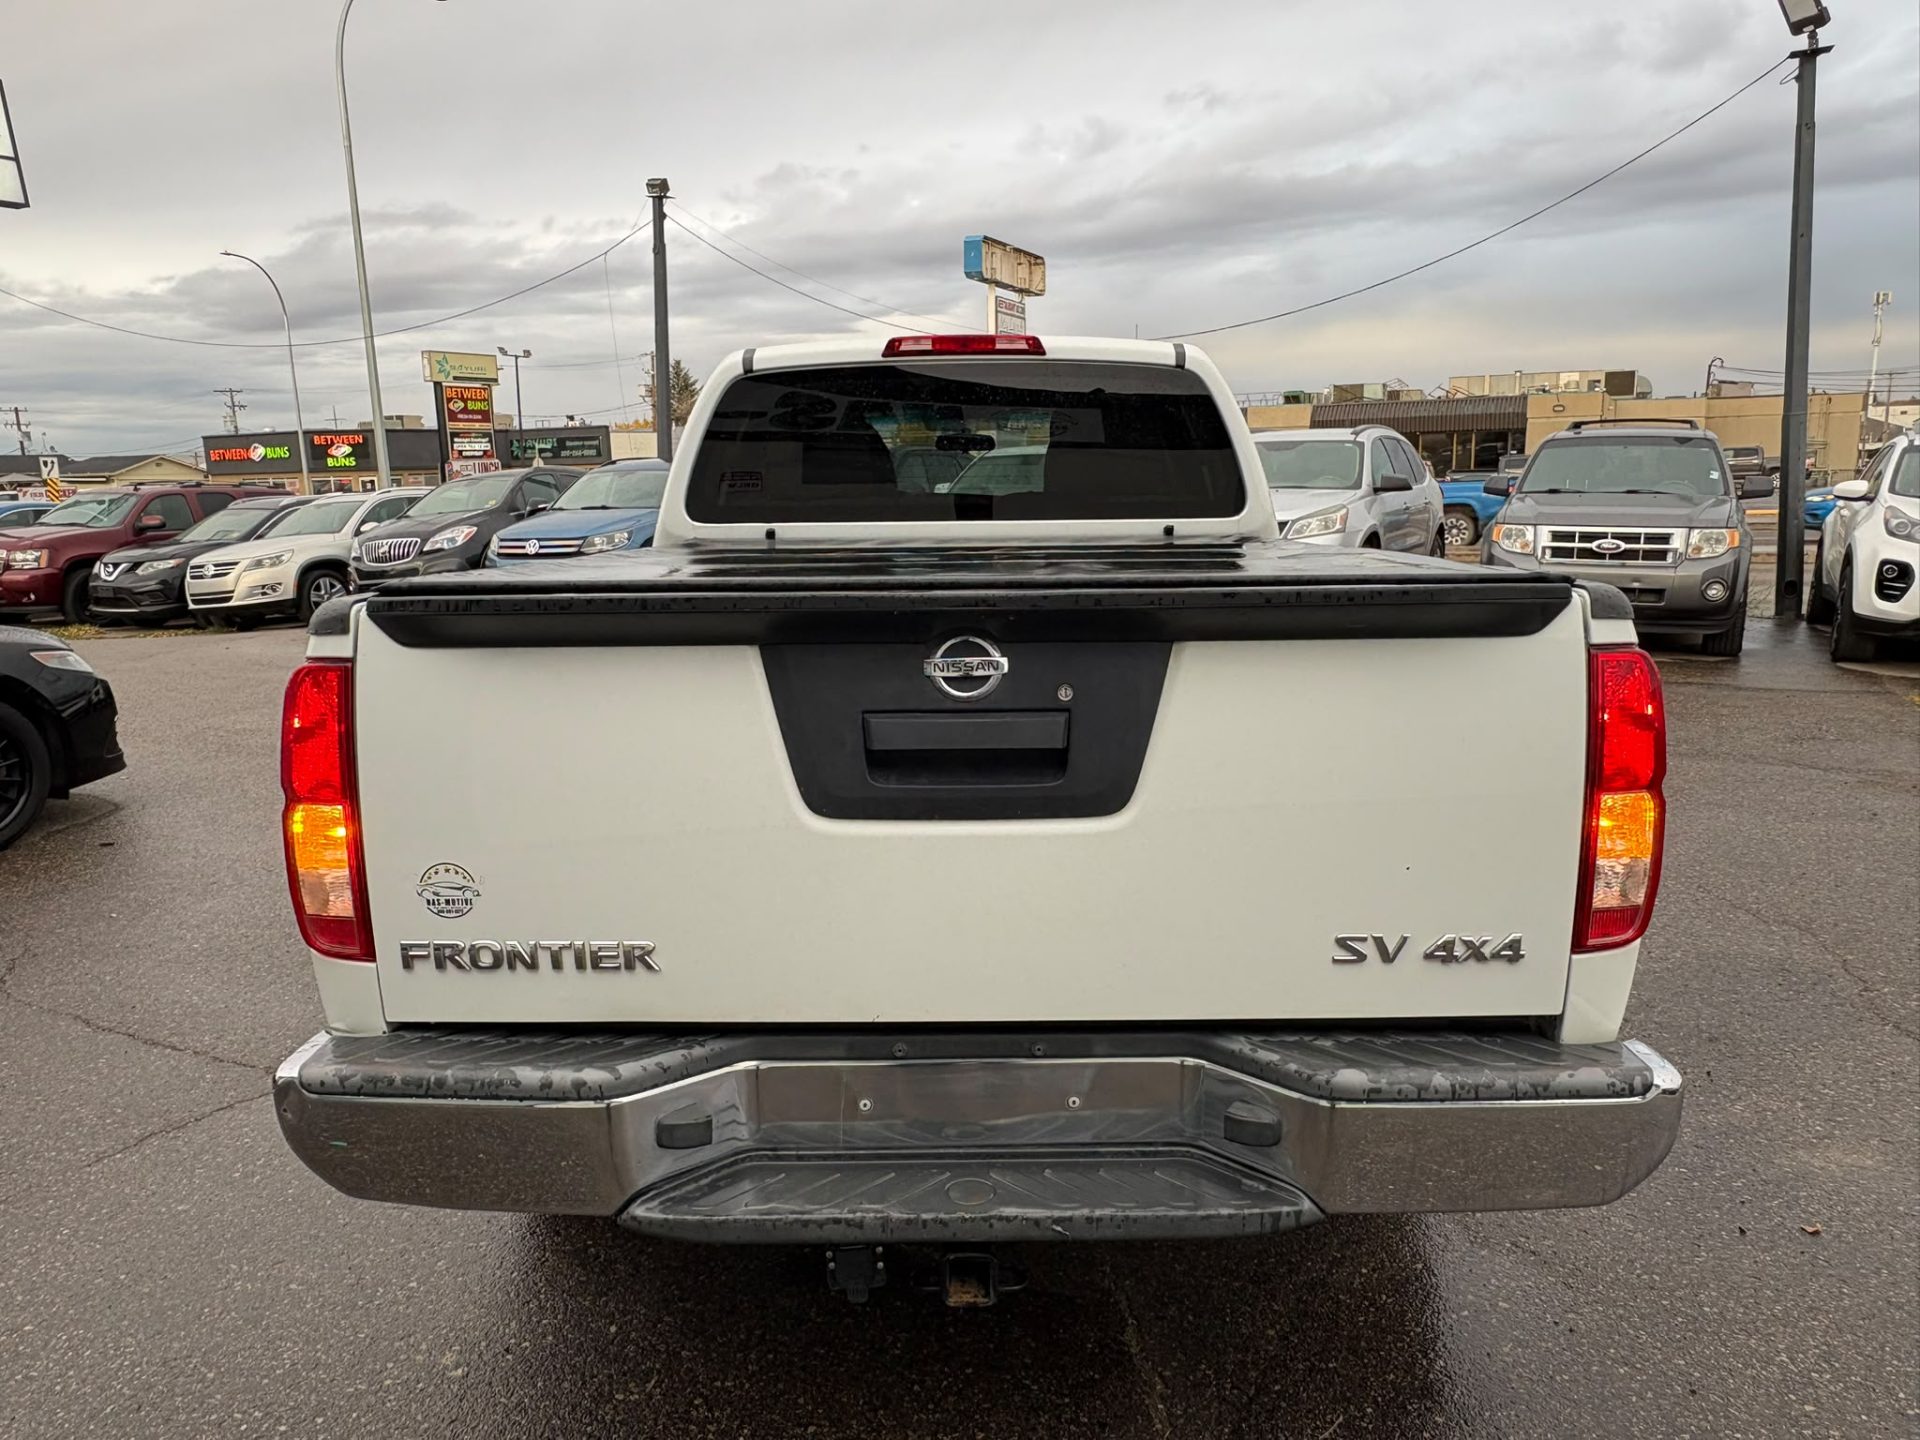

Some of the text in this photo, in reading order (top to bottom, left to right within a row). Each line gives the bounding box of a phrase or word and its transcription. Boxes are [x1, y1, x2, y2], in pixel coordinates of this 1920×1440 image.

[446, 387, 488, 399] BETWEEN
[467, 400, 489, 410] BUNS
[313, 434, 364, 445] BETWEEN
[210, 446, 290, 461] BETWEEN BUNS
[327, 457, 357, 467] BUNS
[933, 661, 999, 673] NISSAN
[1332, 933, 1411, 964] SV
[400, 940, 661, 972] FRONTIER
